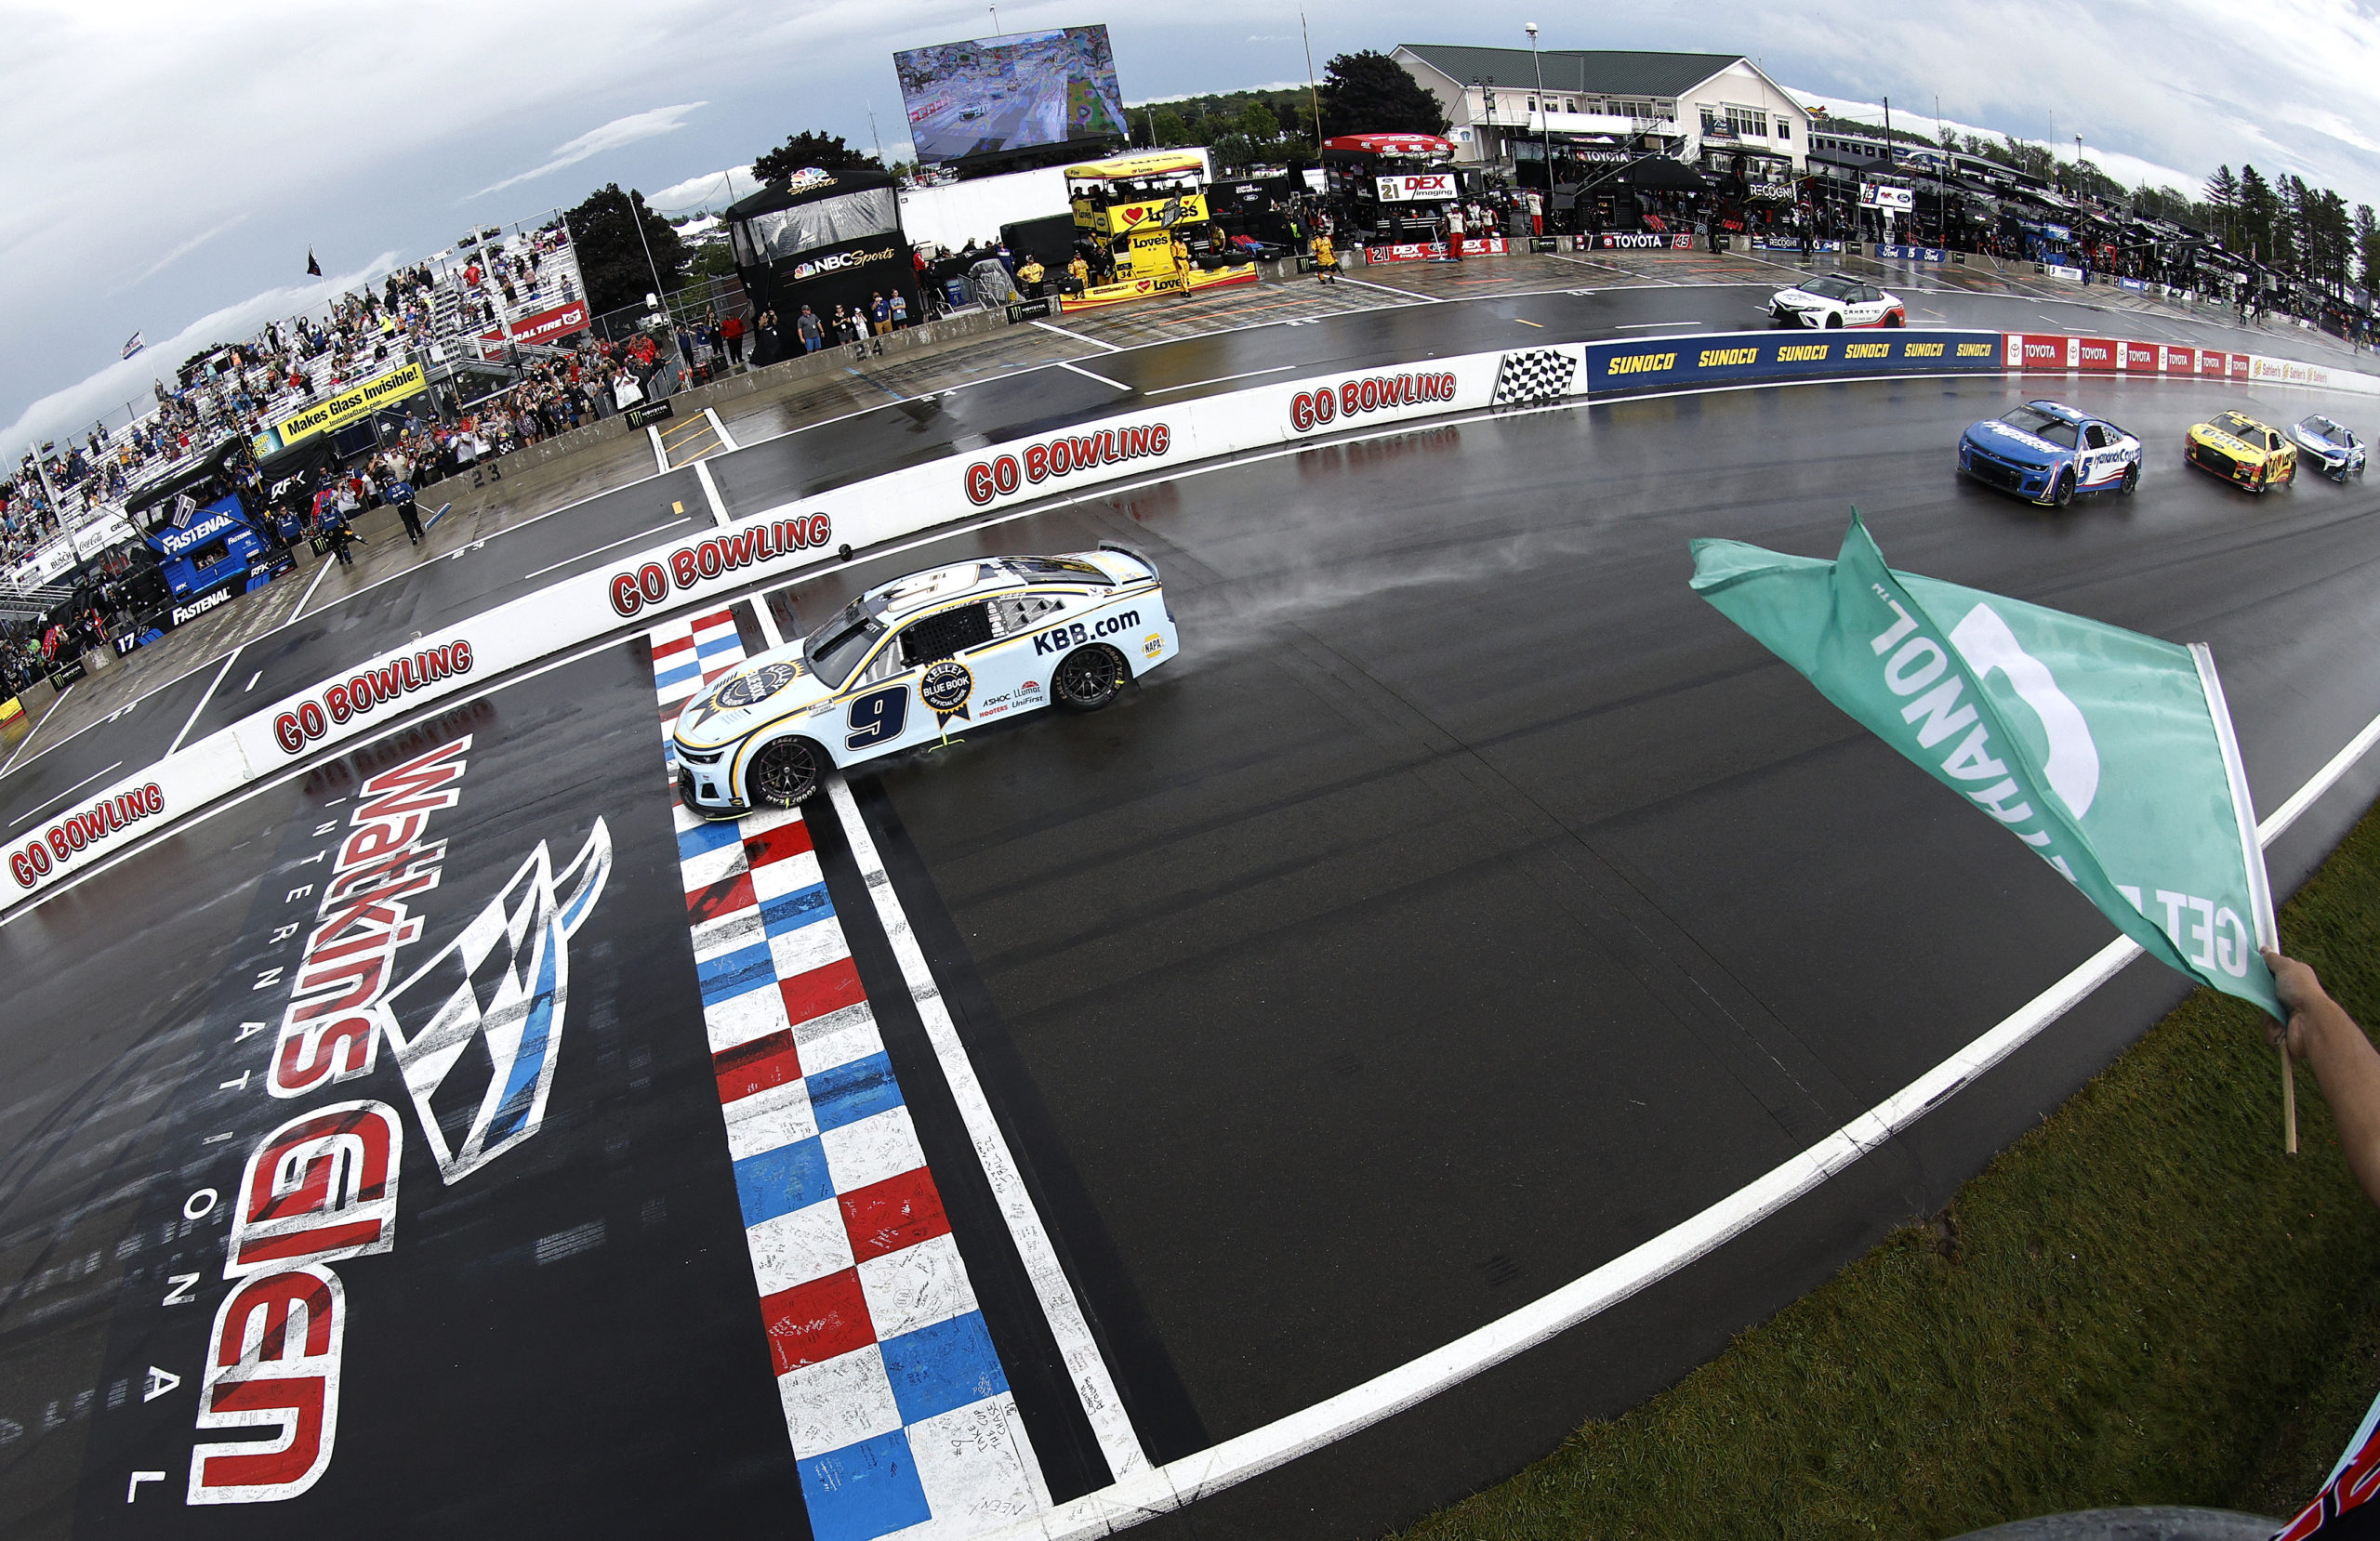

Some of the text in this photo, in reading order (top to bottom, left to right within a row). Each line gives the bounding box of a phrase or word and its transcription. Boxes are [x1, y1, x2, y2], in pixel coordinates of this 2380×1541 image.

[1585, 151, 1629, 162] TOYOTA
[787, 178, 838, 195] Sports
[791, 174, 832, 189] NBC
[1405, 177, 1446, 191] DEX
[1381, 184, 1399, 199] 21
[1416, 189, 1452, 197] imaging
[1750, 182, 1792, 200] RECOGNI
[1613, 236, 1689, 248] TOYOTA 45
[1769, 237, 1796, 248] RECOGNI
[814, 247, 894, 272] NBC Sports
[1372, 246, 1390, 262] 21
[1393, 244, 1420, 255] DEX
[1883, 245, 1939, 261] Ford 15 Ford
[1120, 270, 1131, 279] 34
[536, 318, 562, 335] TIRE
[1699, 348, 1758, 367] SUNOCO
[1777, 345, 1830, 362] SUNOCO
[1844, 343, 1890, 359] SUNOCO
[1904, 343, 1944, 357] SUNOCO
[1956, 343, 1991, 356] SUNOCO
[2025, 345, 2056, 359] TOYOTA
[2082, 348, 2107, 361] TOYOTA
[2128, 349, 2150, 362] TOYOTA
[1607, 353, 1676, 375] SUNOCO
[2169, 353, 2188, 365] TOYOTA
[2203, 356, 2219, 369] TOYOTA
[2232, 361, 2247, 372] TOYOTA
[2263, 363, 2281, 377] Sahlen's
[2290, 365, 2306, 380] Sahlen's
[287, 367, 418, 436] Makes Glass Invisible!
[1289, 372, 1457, 431] GO BOWLING
[329, 400, 382, 427] InvisibleGlass.com
[252, 435, 271, 450] sible
[964, 423, 1170, 506] GO BOWLING
[2077, 456, 2094, 485] 5
[172, 494, 196, 529] 17
[162, 510, 234, 556] FASTENAL
[228, 530, 252, 545] FASTENAL
[50, 551, 73, 570] BUSCH
[251, 561, 270, 577] RFK
[608, 511, 831, 617] GO BOWLING
[171, 586, 231, 626] FASTENAL
[1033, 610, 1141, 656] KBB.com
[118, 632, 135, 652] 17
[1144, 639, 1162, 653] NAPA
[925, 664, 964, 683] KELLEY
[1101, 644, 1123, 690] GOODYER
[922, 676, 970, 697] BLUE BOOK
[273, 640, 473, 754] GO BOWLING
[930, 689, 967, 706] OFFICIAL GUIDE
[1012, 695, 1043, 708] UniFirst
[844, 683, 911, 752] 9
[979, 705, 1008, 718] HOOTERS
[9, 783, 165, 889] GO BOWLING
[186, 733, 473, 1507] Watkins Glen
[127, 797, 351, 1505] INTERNATIONAL
[974, 1410, 988, 1426] CUP
[985, 1402, 1006, 1435] CHASE
[968, 1424, 988, 1453] TAKE
[986, 1430, 1001, 1450] THE
[952, 1440, 974, 1457] #9
